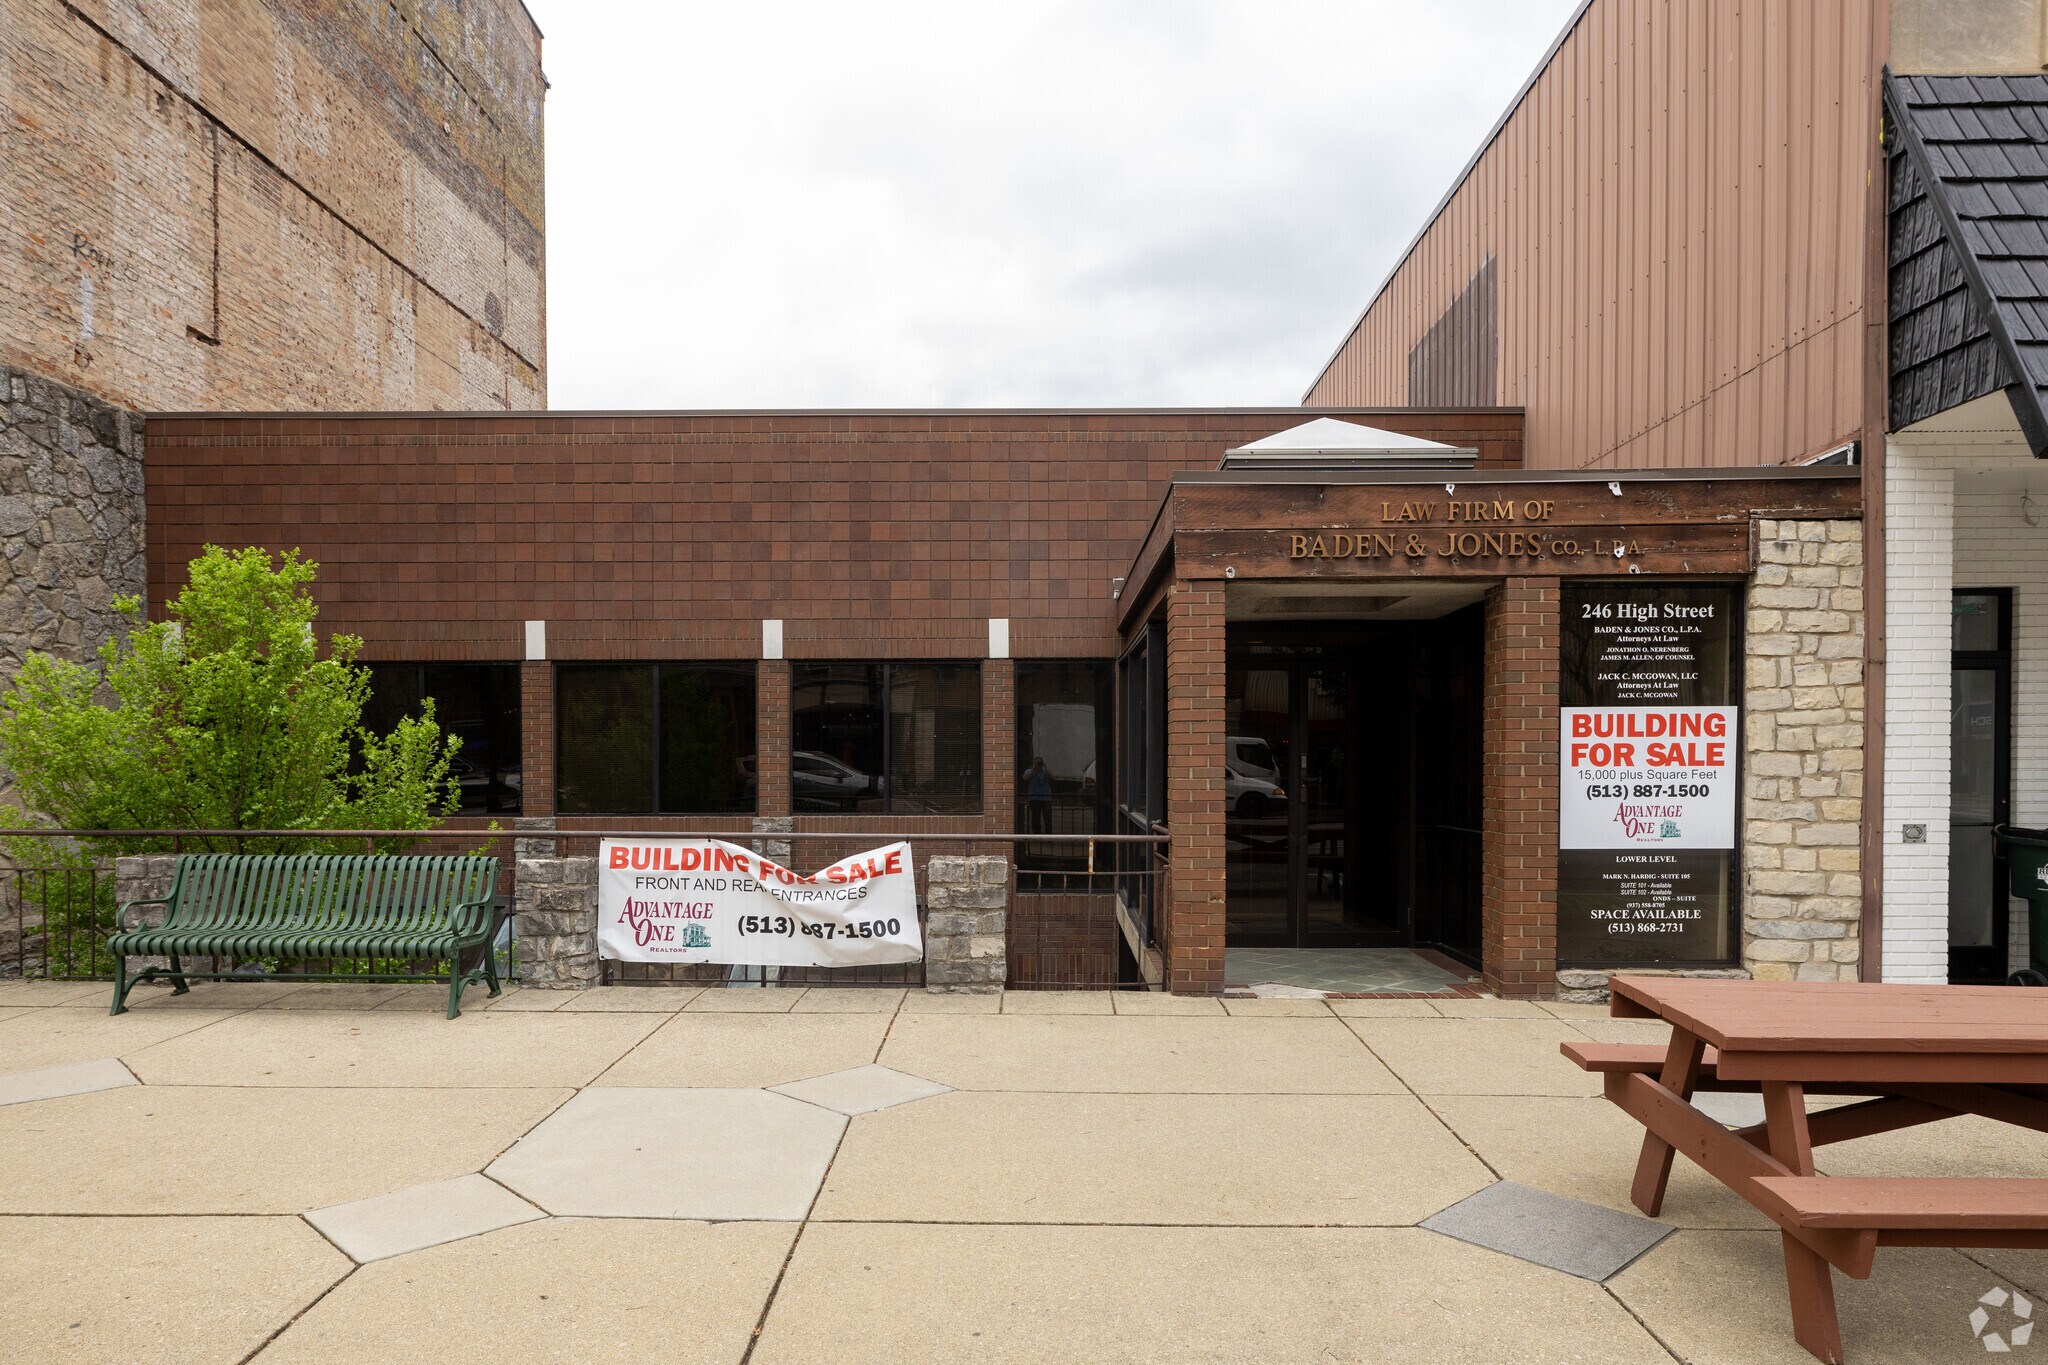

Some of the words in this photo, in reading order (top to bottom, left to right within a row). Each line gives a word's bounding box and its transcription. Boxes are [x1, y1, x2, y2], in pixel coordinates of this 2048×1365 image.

[1382, 501, 1435, 522] LAW
[1448, 501, 1515, 521] FIRM
[1523, 500, 1555, 520] OF
[1290, 534, 1396, 559] BADEN
[1404, 533, 1427, 557] &
[1437, 532, 1542, 557] JONES
[1581, 603, 1612, 619] 246
[1616, 603, 1658, 622] High
[1663, 603, 1715, 619] Street
[1594, 626, 1623, 634] BADEN
[1624, 626, 1632, 634] &
[1633, 626, 1660, 634] JONES
[1661, 626, 1679, 635] CO.,
[1680, 626, 1702, 634] L.P.A.
[1616, 635, 1652, 643] Attorneys
[1616, 682, 1652, 690] Attorneys
[1631, 673, 1680, 681] MCGOWAN,
[1572, 713, 1727, 738] BUILDING
[1571, 743, 1636, 768] FOR
[1645, 742, 1726, 767] SALE
[1578, 769, 1617, 781] 15,000
[1619, 769, 1644, 782] plus
[1646, 769, 1688, 781] Square
[1691, 769, 1718, 780] Feet
[1586, 784, 1629, 801] (513)
[1632, 784, 1710, 798] 887-1500
[1613, 802, 1683, 827] ADVANTAGE
[1625, 817, 1655, 839] ONE
[609, 846, 750, 872] BUILDING
[826, 851, 903, 885] SALE
[1616, 855, 1648, 863] LOWER
[1649, 855, 1677, 863] LEVEL
[635, 877, 690, 890] FRONT
[693, 878, 727, 891] AND
[732, 879, 767, 893] REA
[771, 887, 868, 902] ENTRANCES
[617, 895, 714, 931] ADVANTAGE
[1590, 909, 1630, 919] SPACE
[1632, 909, 1702, 919] AVAILABLE
[635, 918, 675, 947] ONE
[737, 915, 796, 938] (513)
[801, 918, 901, 940] 887-1500
[1608, 922, 1635, 934] (513)
[1637, 922, 1684, 933] 868-2731
